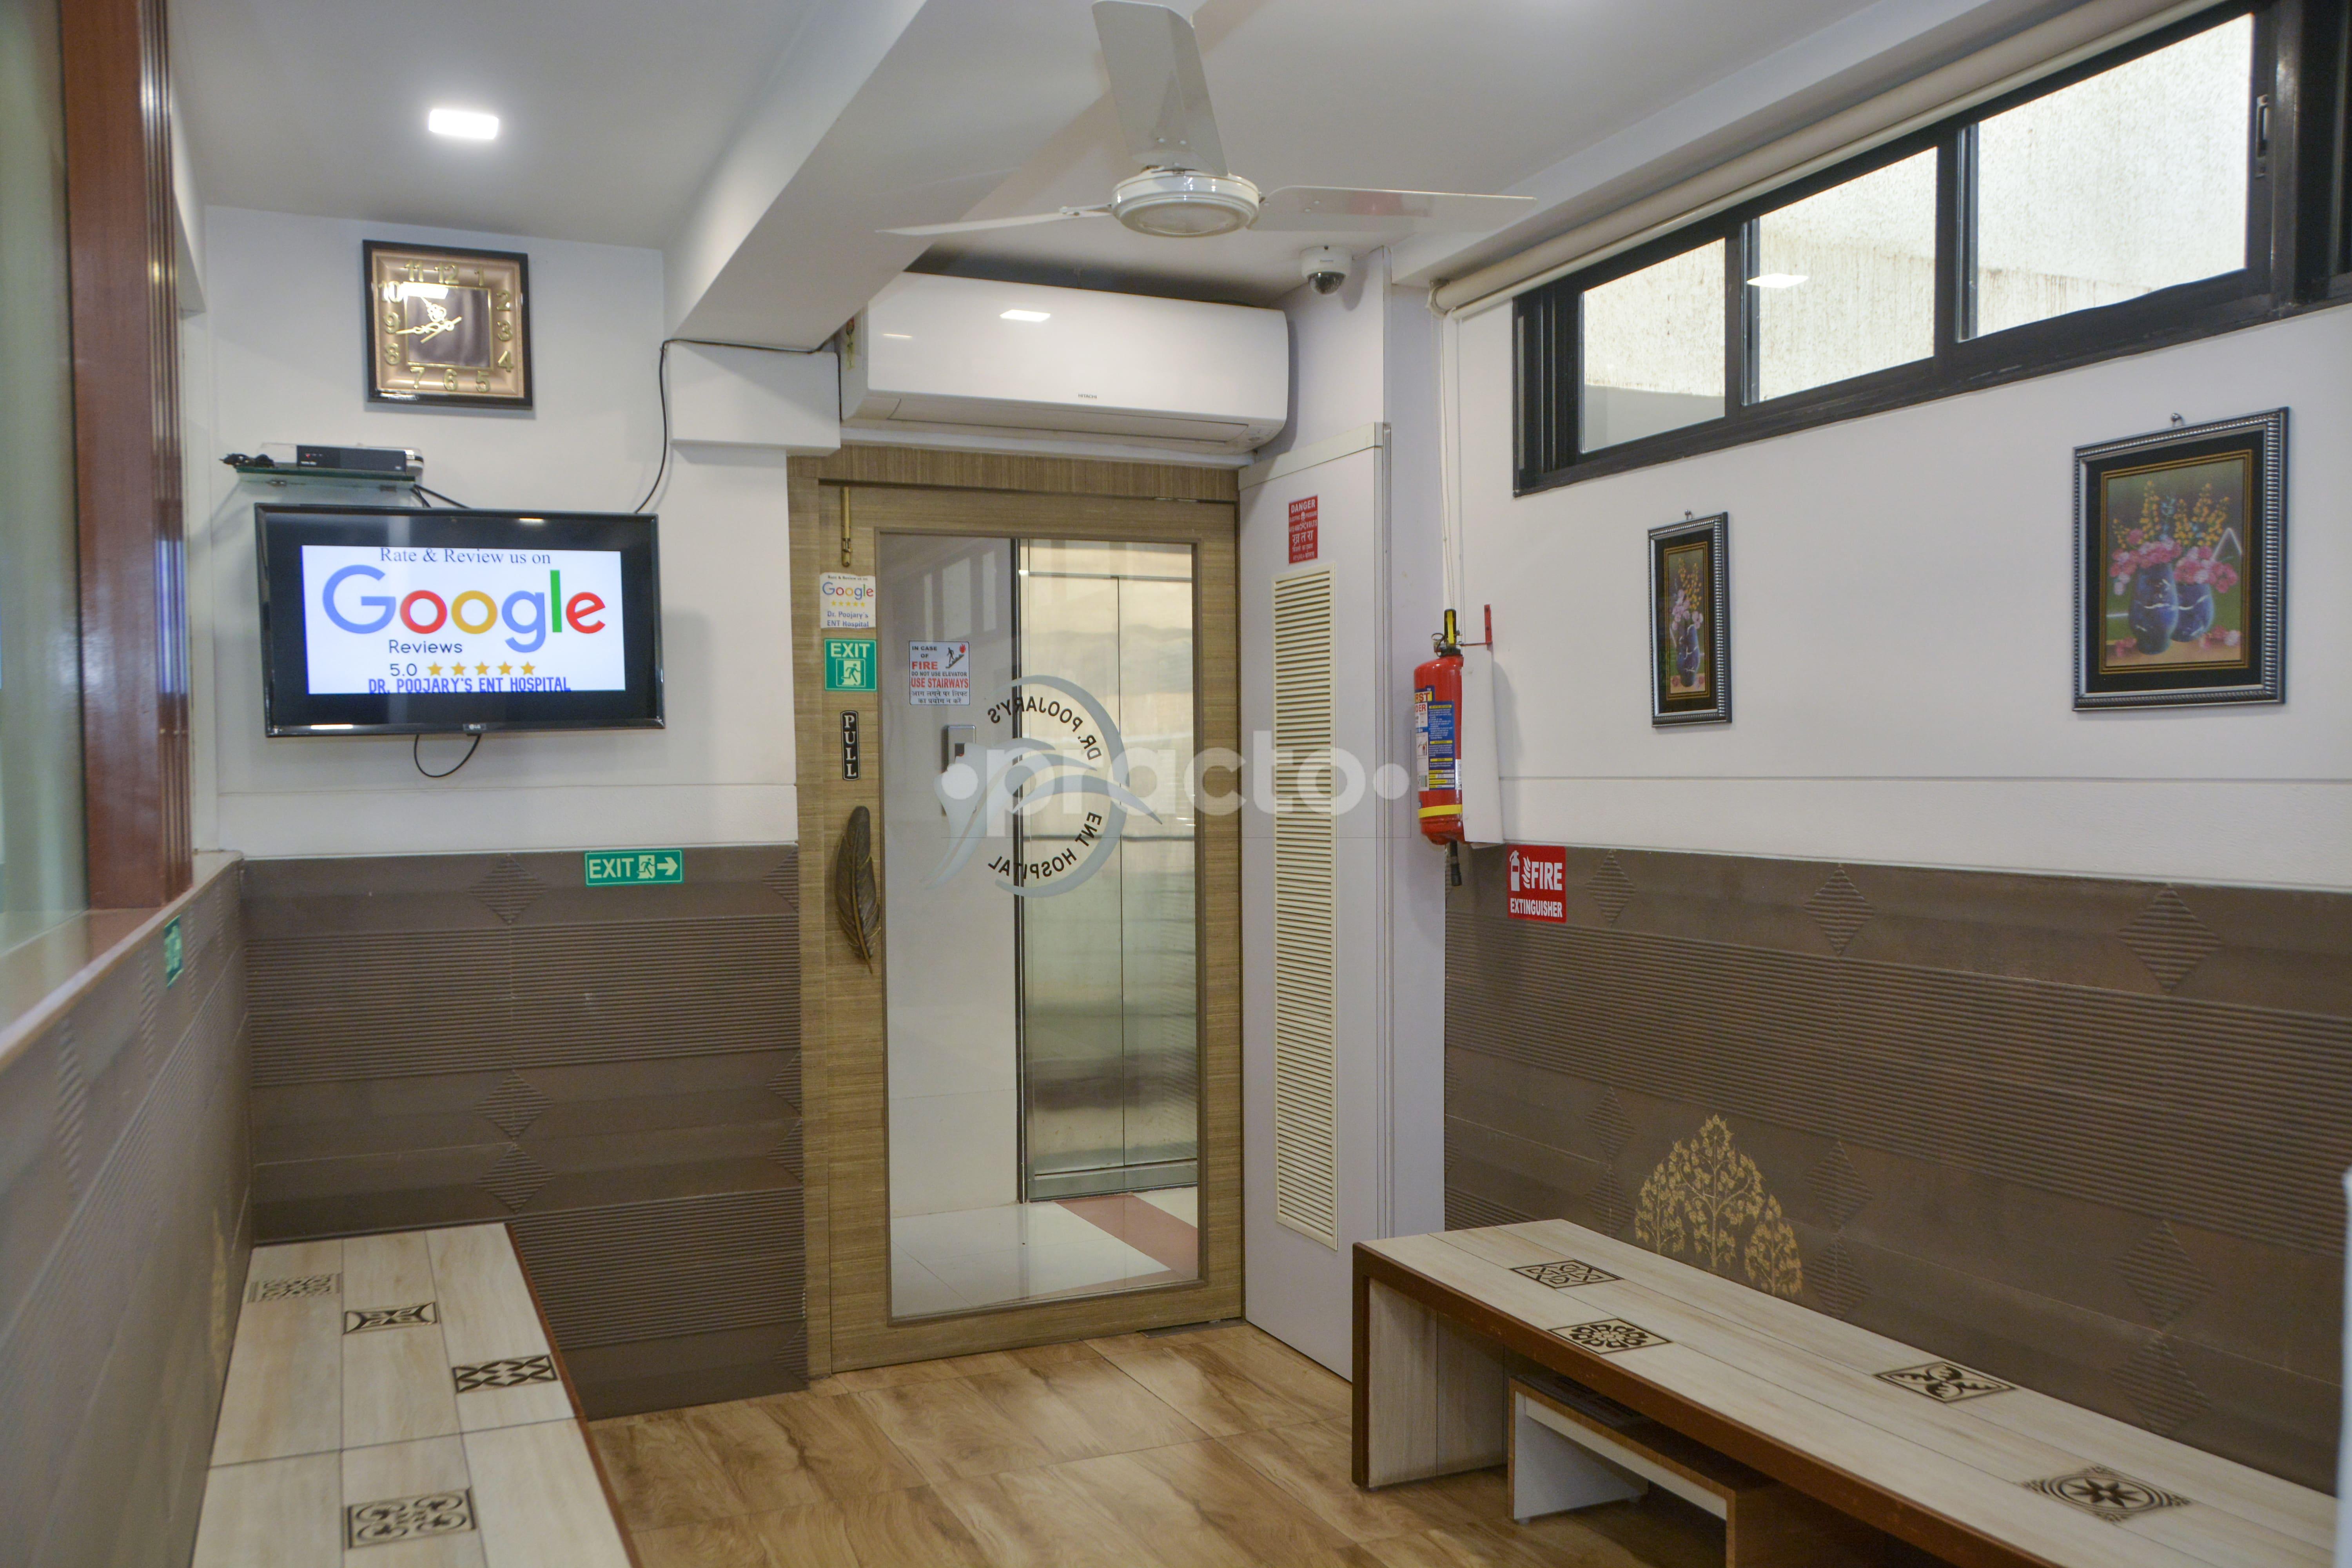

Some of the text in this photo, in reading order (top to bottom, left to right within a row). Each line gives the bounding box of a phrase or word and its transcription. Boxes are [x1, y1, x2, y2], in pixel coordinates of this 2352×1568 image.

[405, 260, 424, 282] 11
[434, 261, 459, 285] 12
[474, 267, 485, 287] 1
[378, 280, 404, 303] 10
[497, 290, 511, 311] 2
[384, 312, 400, 334] 9
[497, 319, 512, 342] 3
[385, 343, 401, 365] 8
[498, 350, 514, 372] 4
[410, 366, 425, 389] 7
[443, 369, 458, 392] 6
[475, 371, 490, 392] 5
[1291, 499, 1316, 514] DANGER
[380, 547, 551, 564] Rate & Review us on
[822, 582, 874, 600] Google
[322, 564, 606, 653] Google
[838, 611, 868, 619] Poojary's
[388, 640, 463, 653] Reviews
[830, 642, 870, 658] EXIT
[390, 663, 417, 677] 5.0
[911, 661, 938, 670] FIRE
[368, 677, 572, 694] DR. POOJARY'S ENT HOSPITAL
[911, 677, 969, 688] USE STAIRWAYS
[844, 715, 857, 777] PULL
[588, 857, 634, 879] EXIT
[1531, 861, 1563, 891] FIRE
[1510, 898, 1563, 918] EXTINGUISHER
